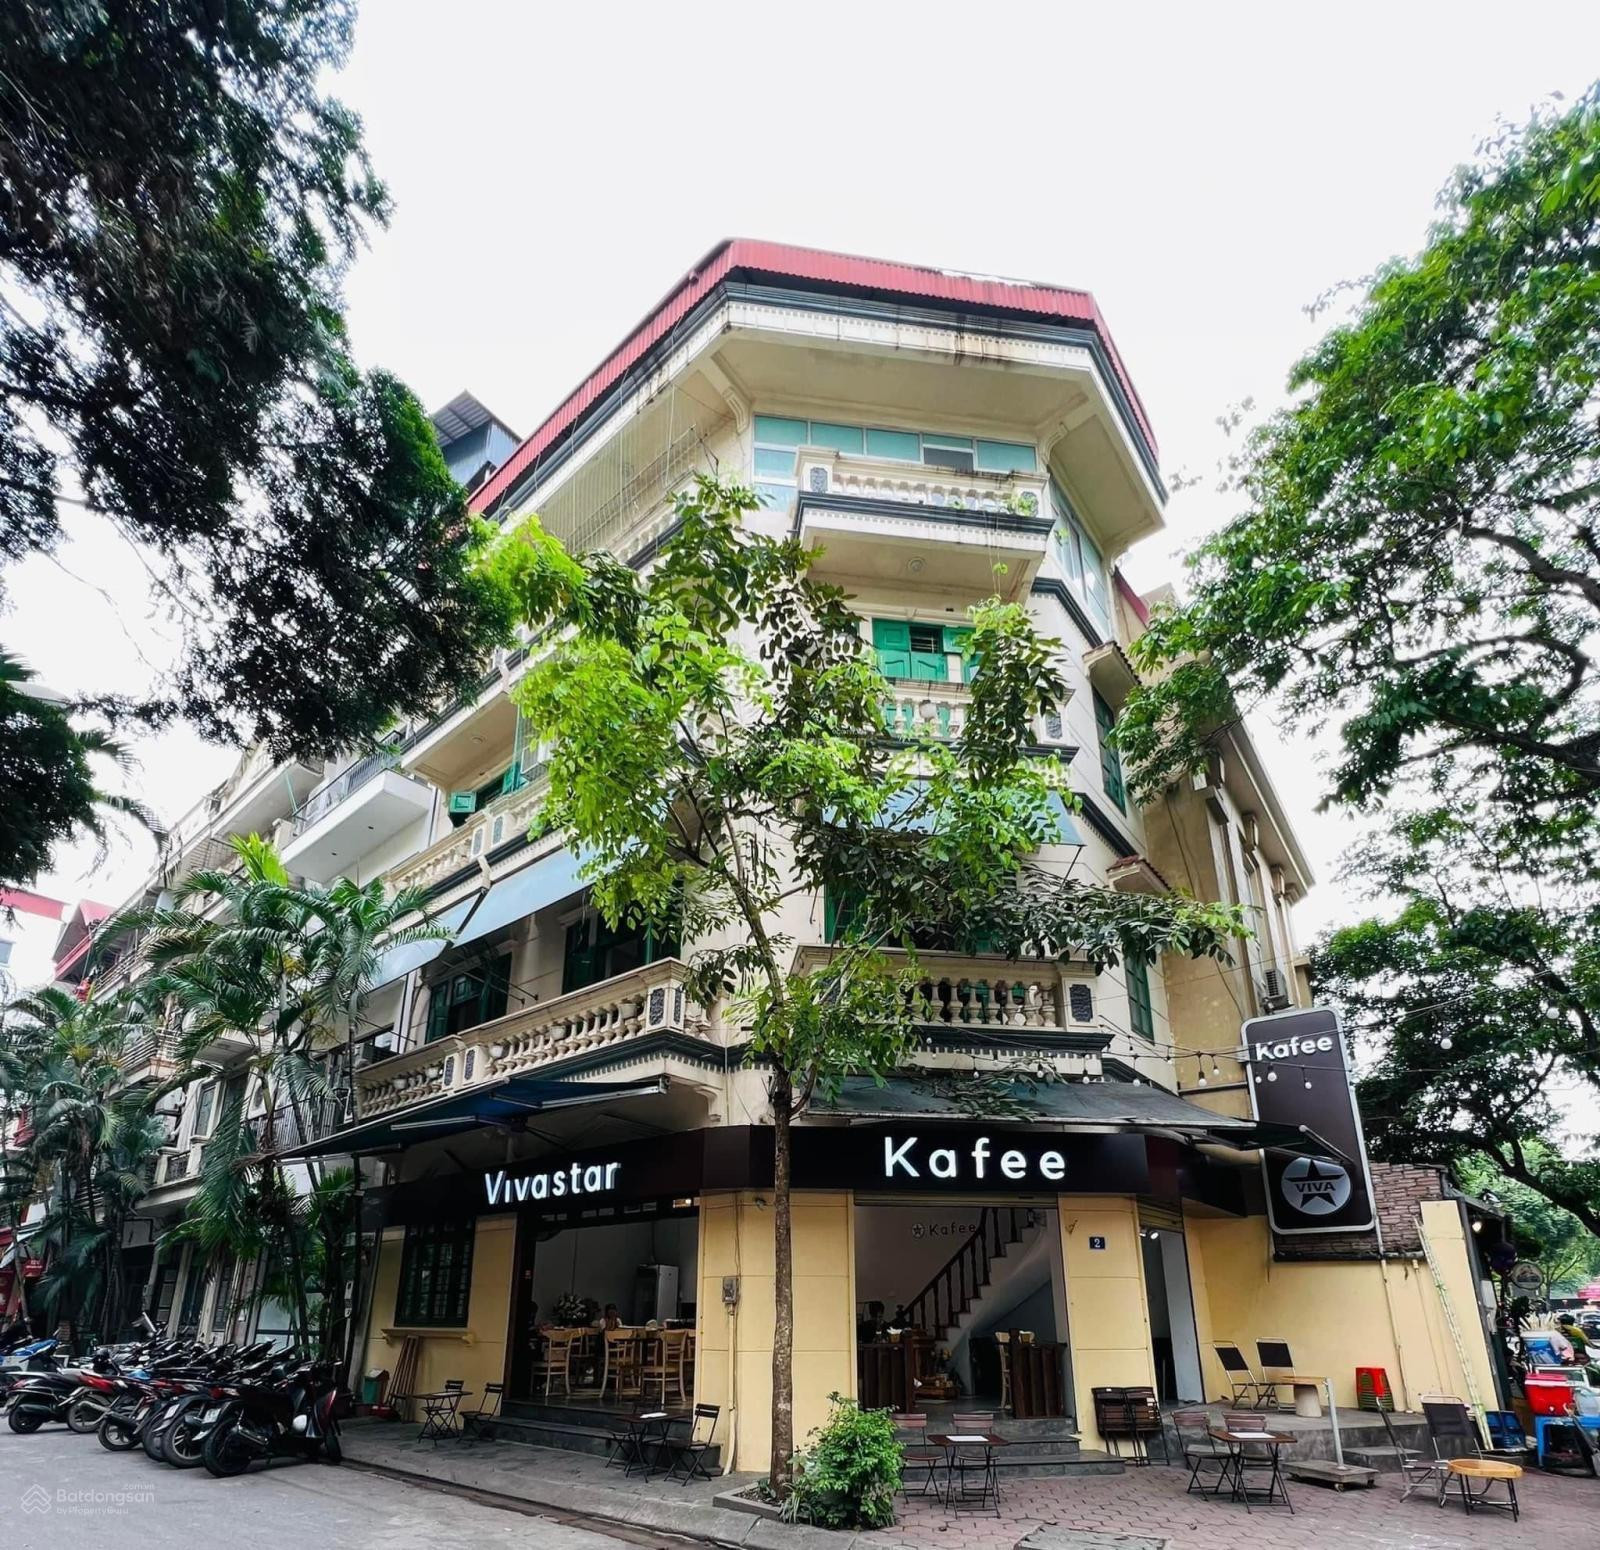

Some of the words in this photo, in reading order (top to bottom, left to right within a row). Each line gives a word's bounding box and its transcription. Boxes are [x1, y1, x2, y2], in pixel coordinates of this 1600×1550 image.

[1255, 1036, 1333, 1062] Kafee
[884, 1136, 1067, 1180] Kafee
[484, 1161, 620, 1205] Vivastar
[1293, 1181, 1336, 1194] VIVA
[929, 1221, 977, 1237] Kafee
[1094, 1238, 1101, 1248] 2
